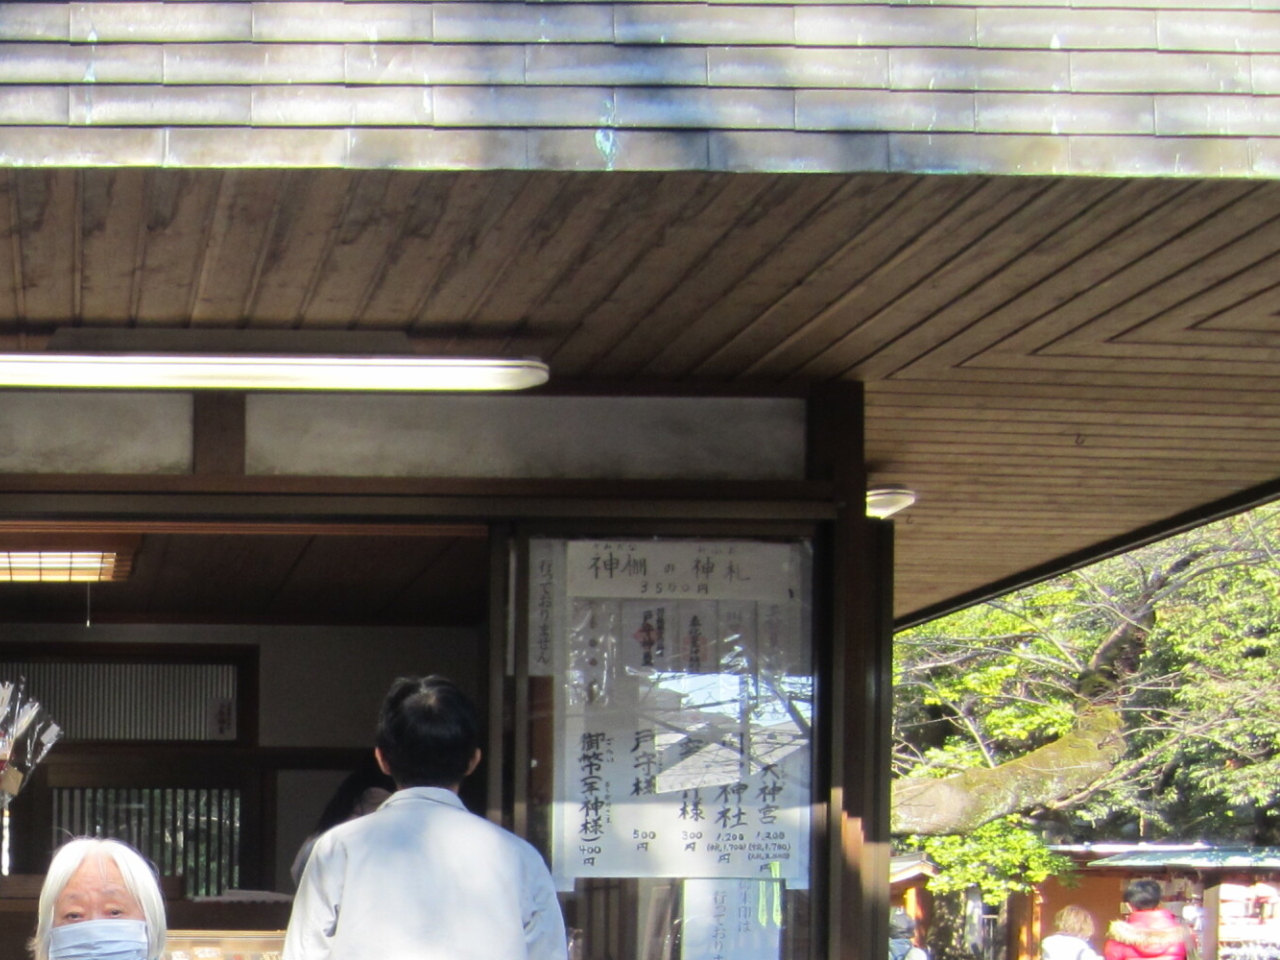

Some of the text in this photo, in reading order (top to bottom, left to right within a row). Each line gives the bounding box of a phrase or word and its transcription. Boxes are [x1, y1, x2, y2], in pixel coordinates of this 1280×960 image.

[630, 729, 657, 796] 戸守様
[632, 829, 657, 840] 500
[681, 830, 704, 841] 300
[578, 845, 603, 855] 400
[637, 842, 649, 852] 円
[684, 841, 696, 852] 円
[583, 857, 596, 867] 円
[717, 852, 731, 864] 円
